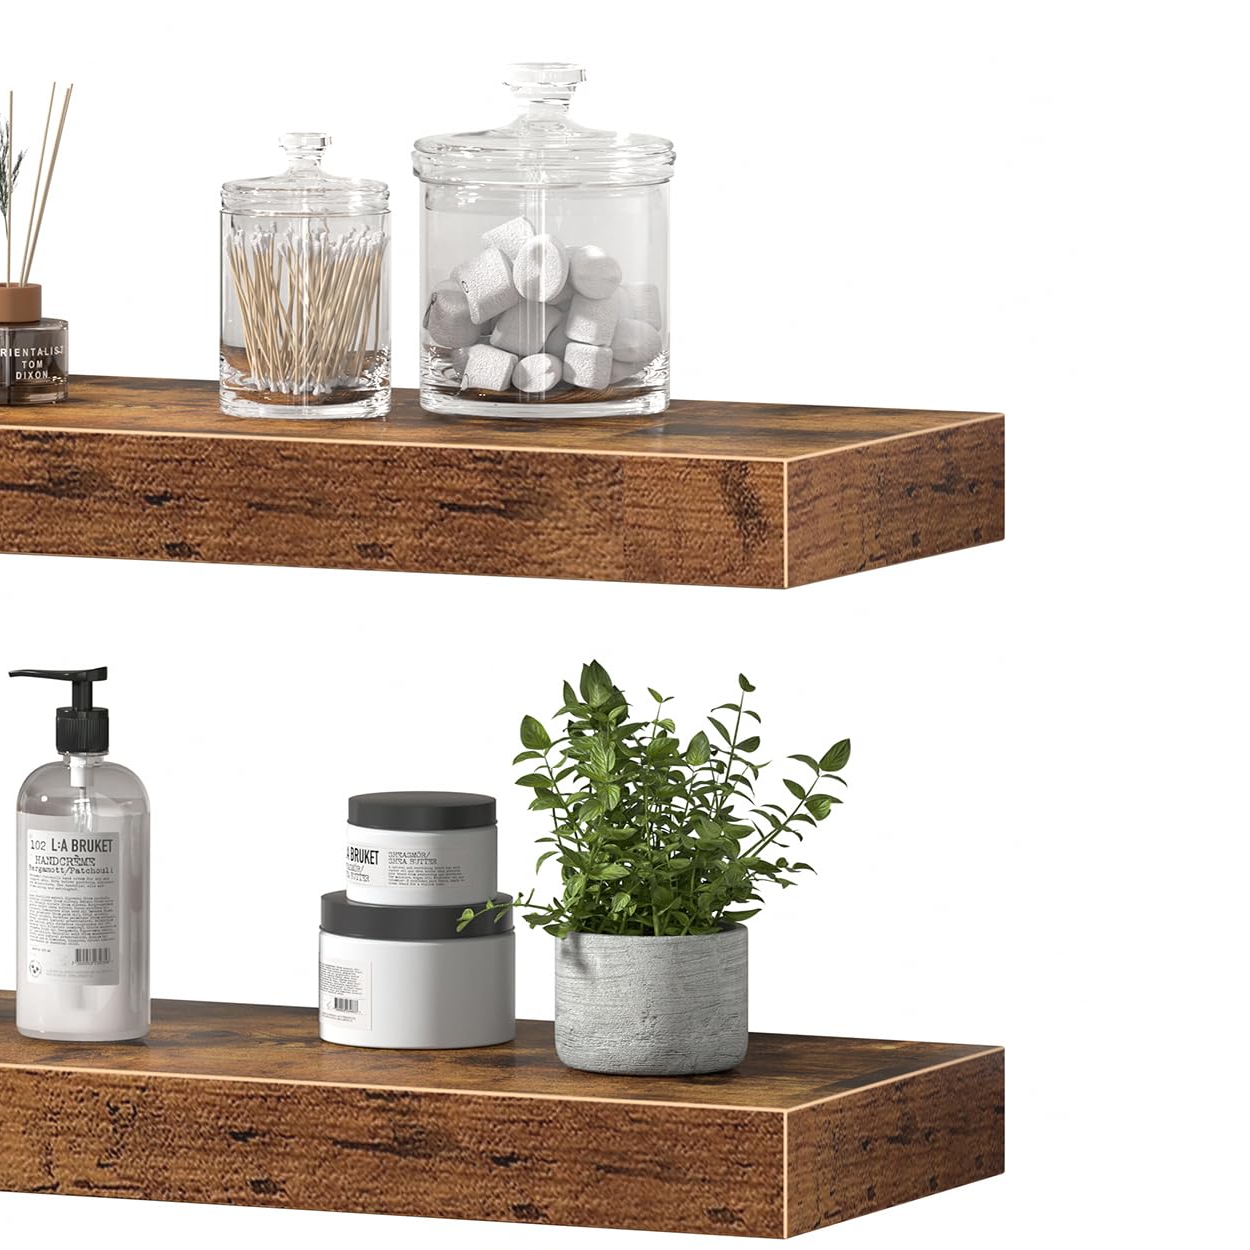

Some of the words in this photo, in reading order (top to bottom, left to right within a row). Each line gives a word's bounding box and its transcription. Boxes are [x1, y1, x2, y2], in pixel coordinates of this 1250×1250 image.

[22, 360, 43, 369] TOM
[15, 371, 48, 380] DIXON
[51, 838, 68, 852] L:A
[71, 838, 113, 853] BRUKET
[350, 847, 379, 865] BRUKET
